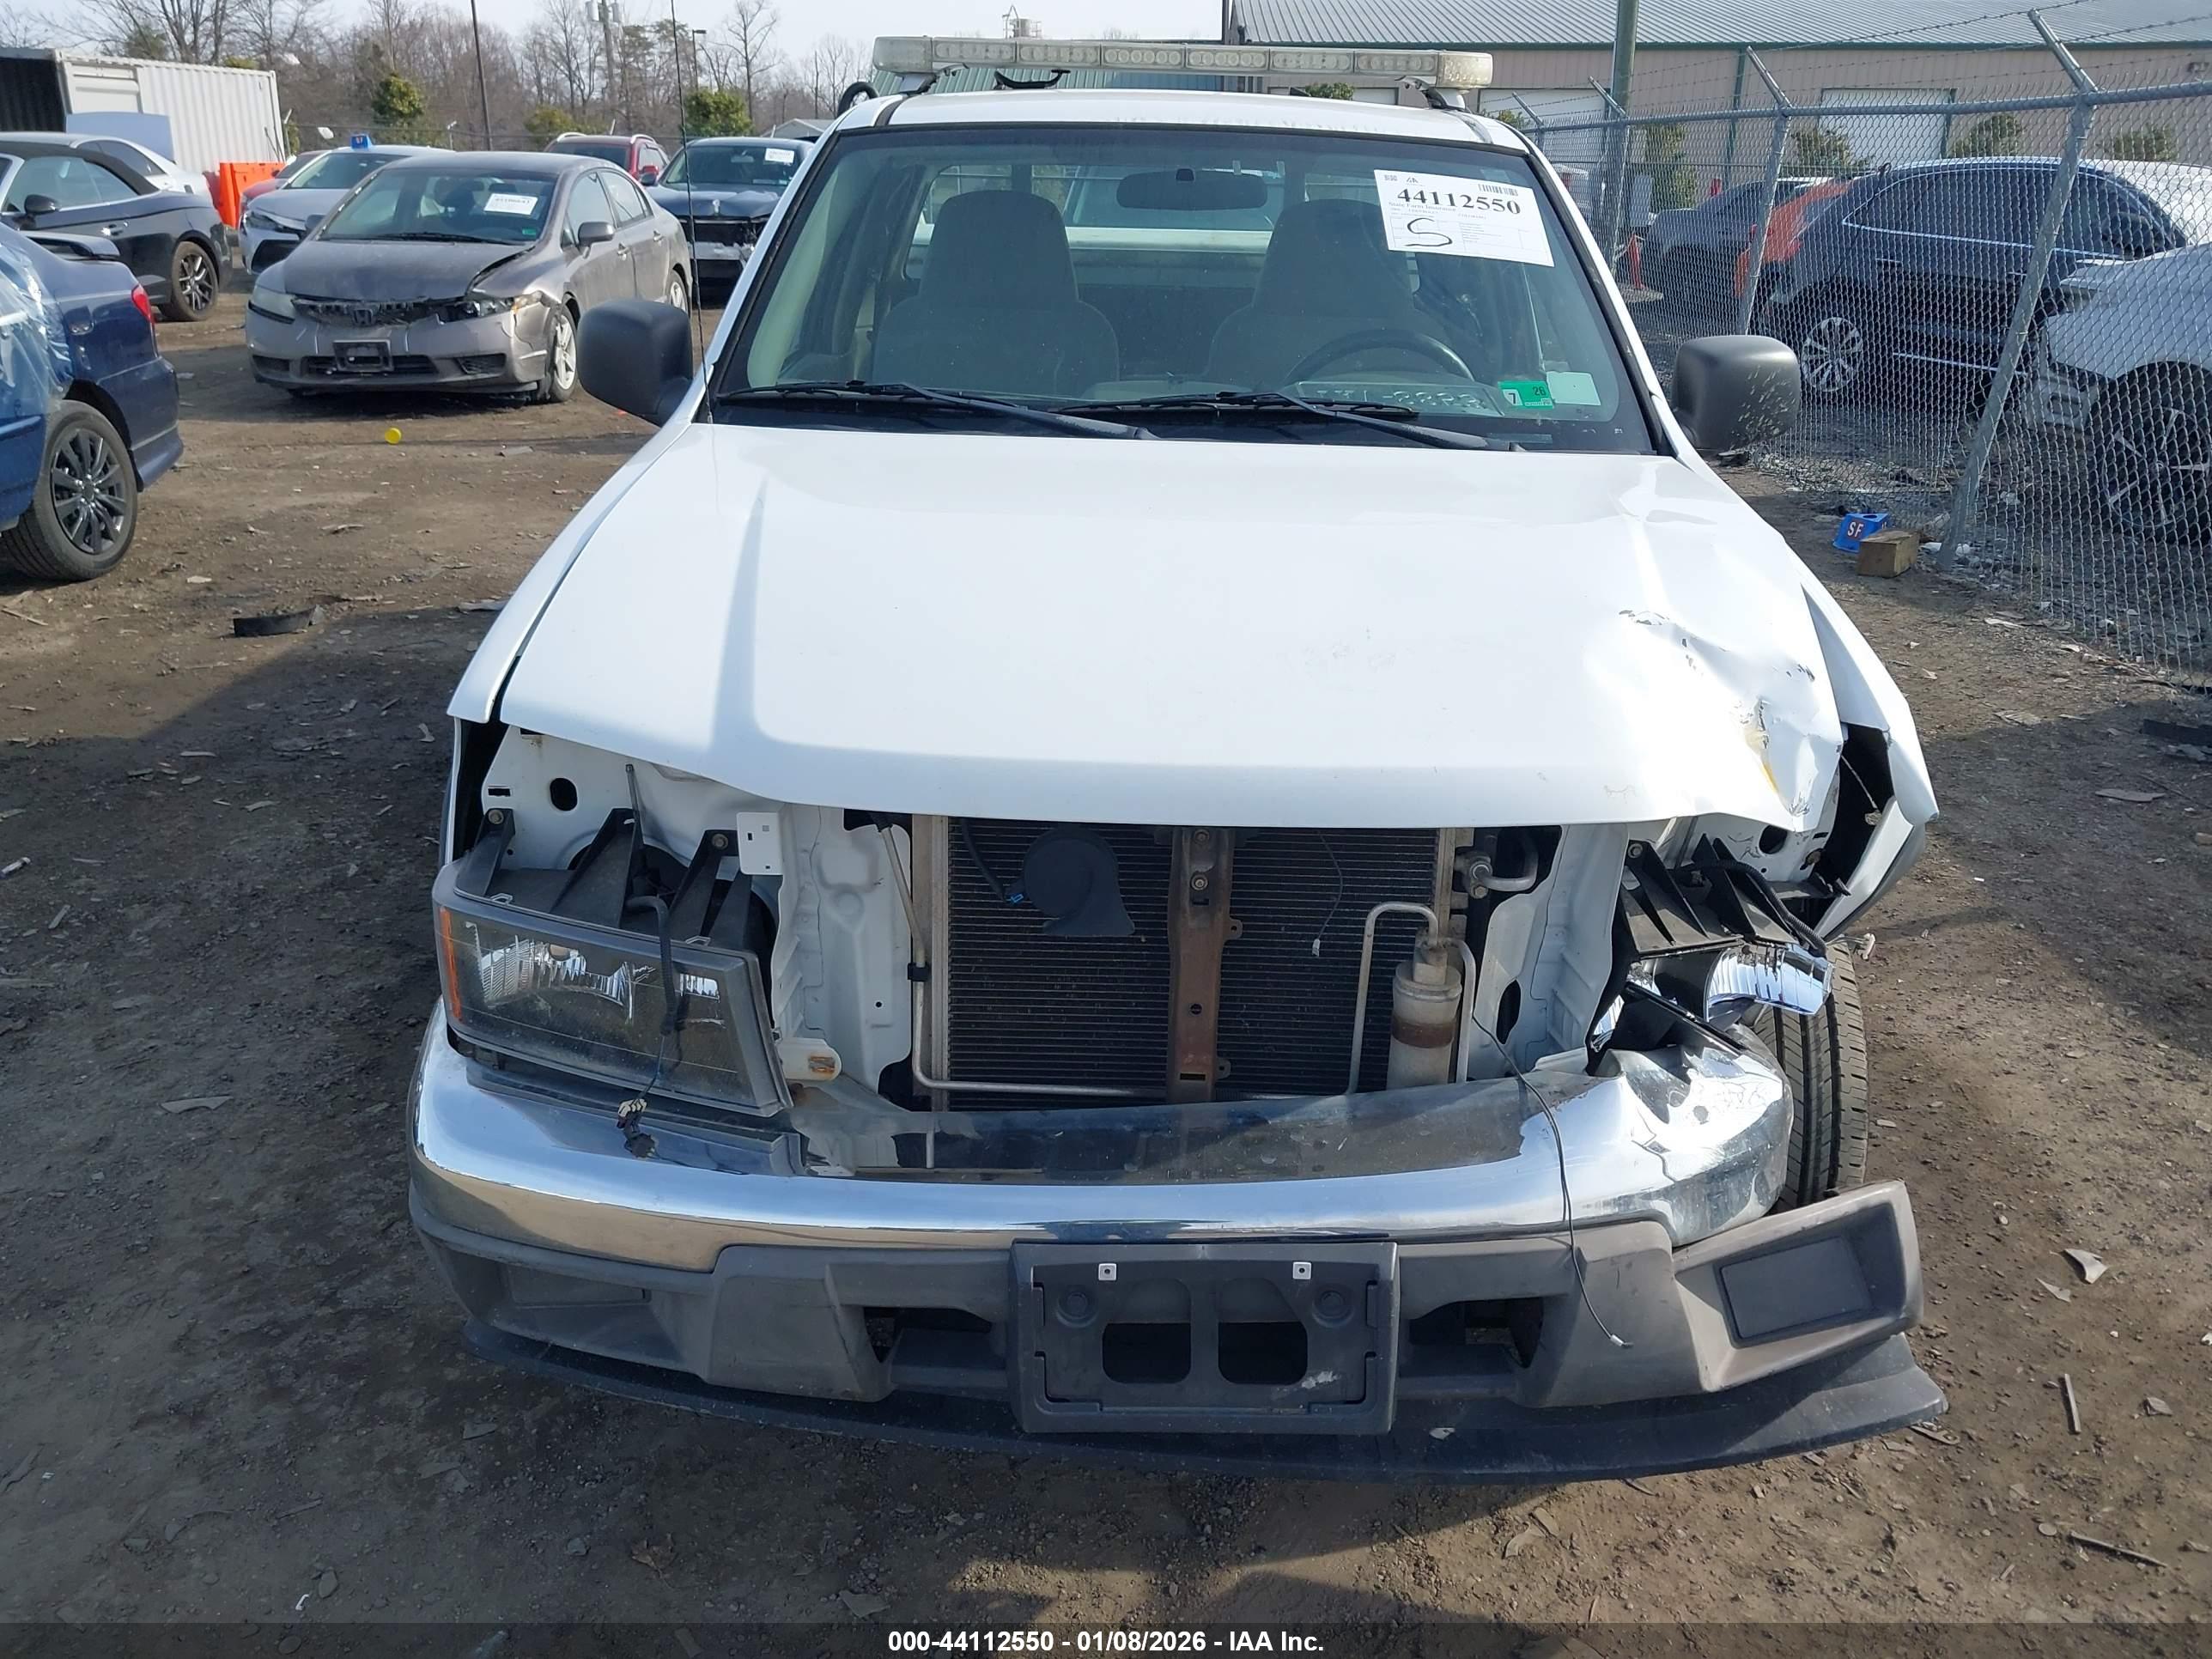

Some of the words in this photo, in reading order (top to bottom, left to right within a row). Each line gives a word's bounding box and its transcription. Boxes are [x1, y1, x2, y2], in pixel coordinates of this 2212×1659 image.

[1397, 188, 1522, 215] 44112550
[1403, 217, 1453, 247] S
[1508, 392, 1516, 404] 7
[1847, 521, 1864, 538] SF
